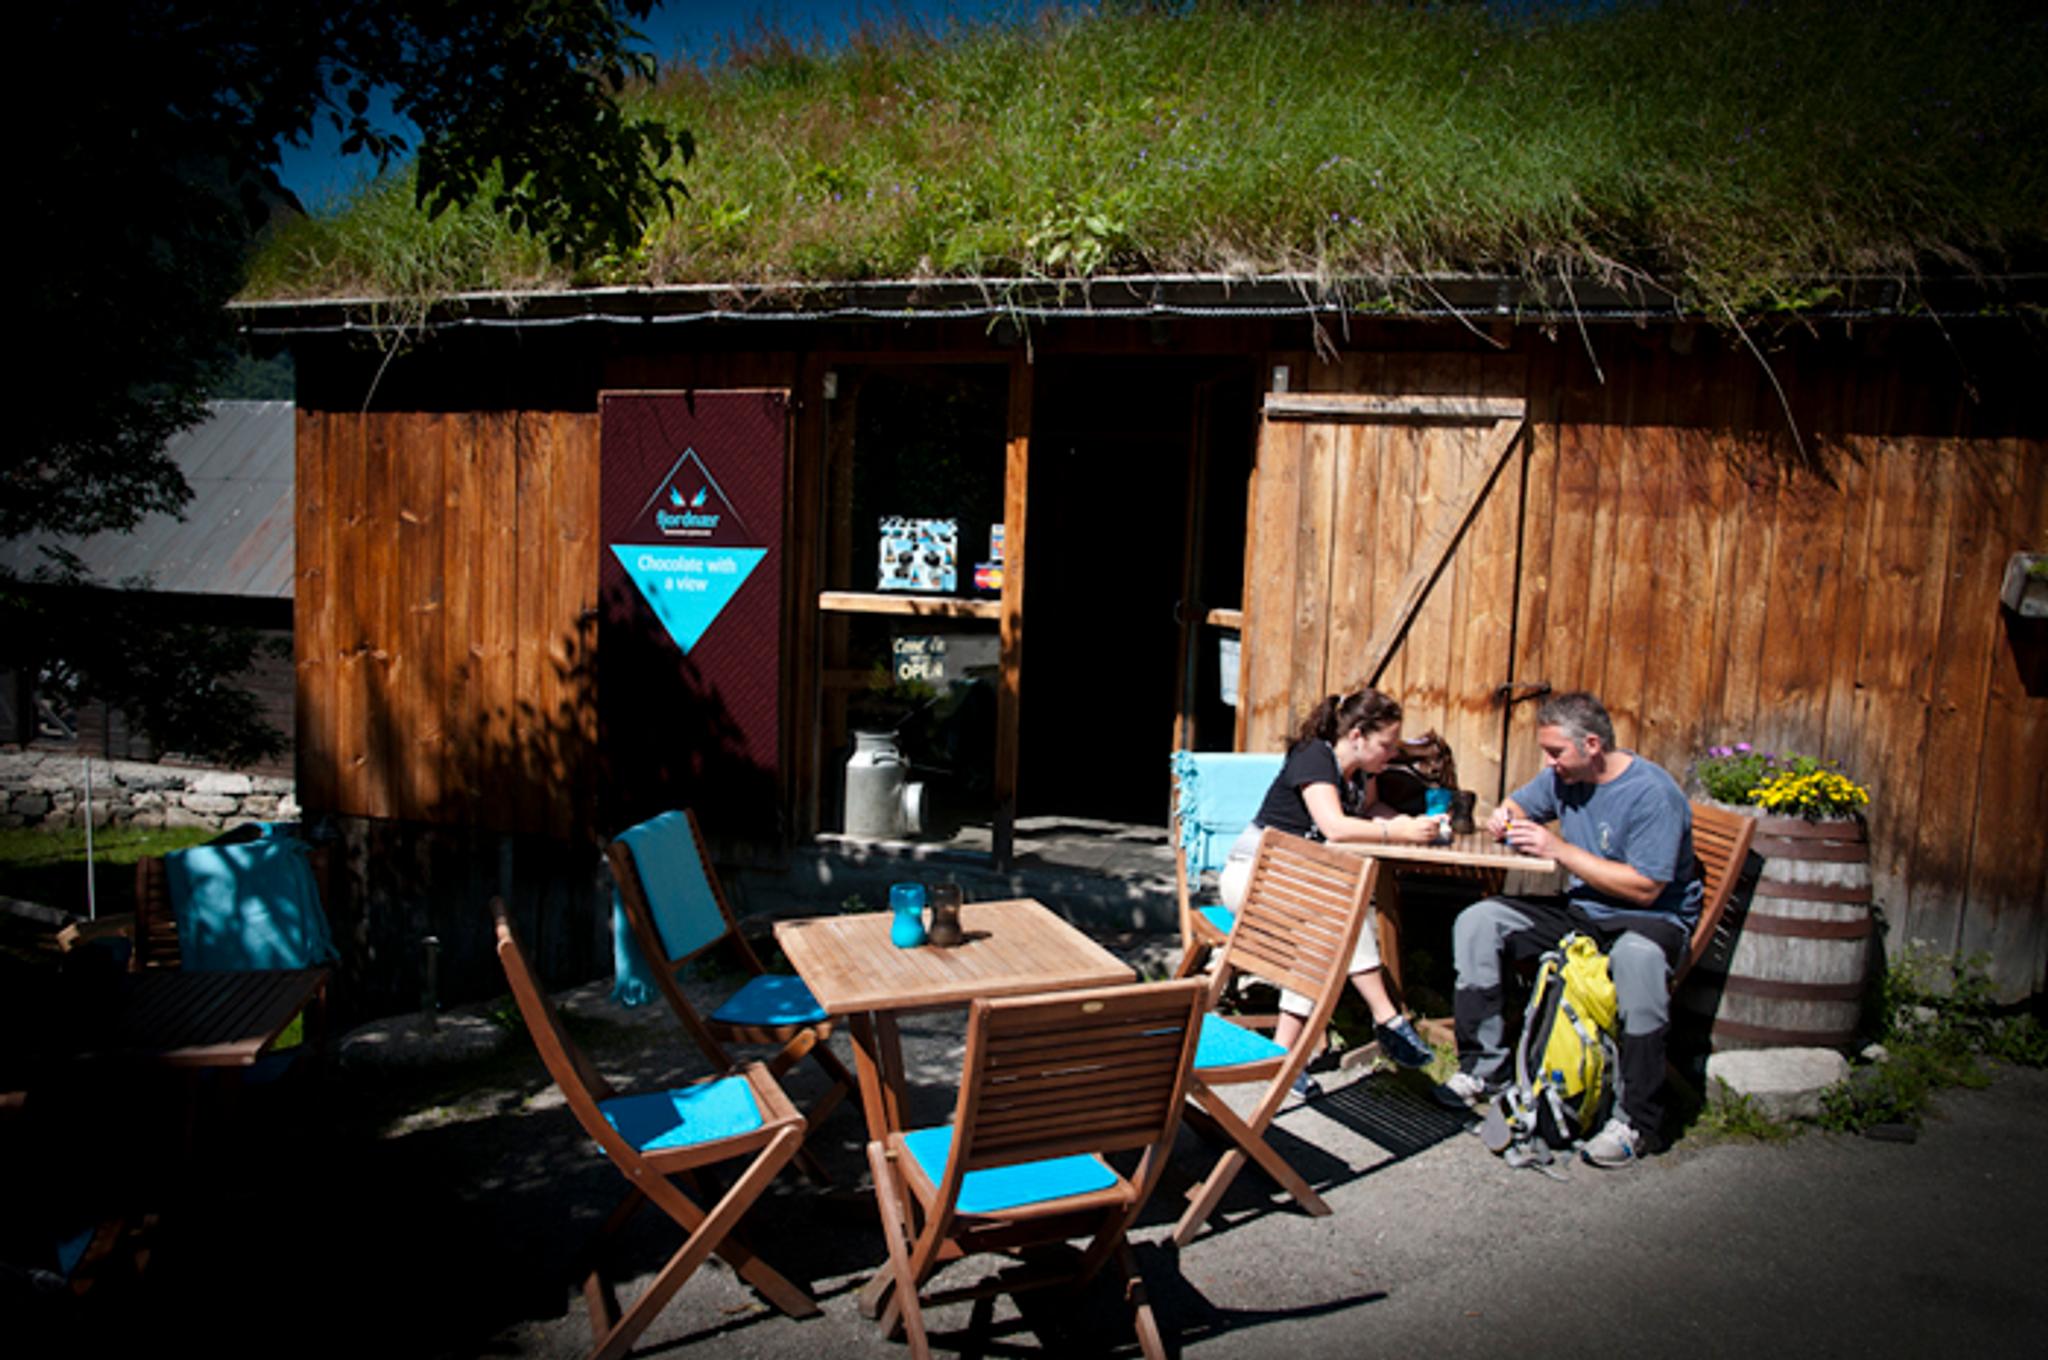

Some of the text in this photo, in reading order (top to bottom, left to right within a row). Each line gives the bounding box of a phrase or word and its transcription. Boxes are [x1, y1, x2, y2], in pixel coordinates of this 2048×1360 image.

[638, 554, 736, 574] Chocolate with
[676, 575, 708, 592] view
[898, 660, 943, 681] OPEN
